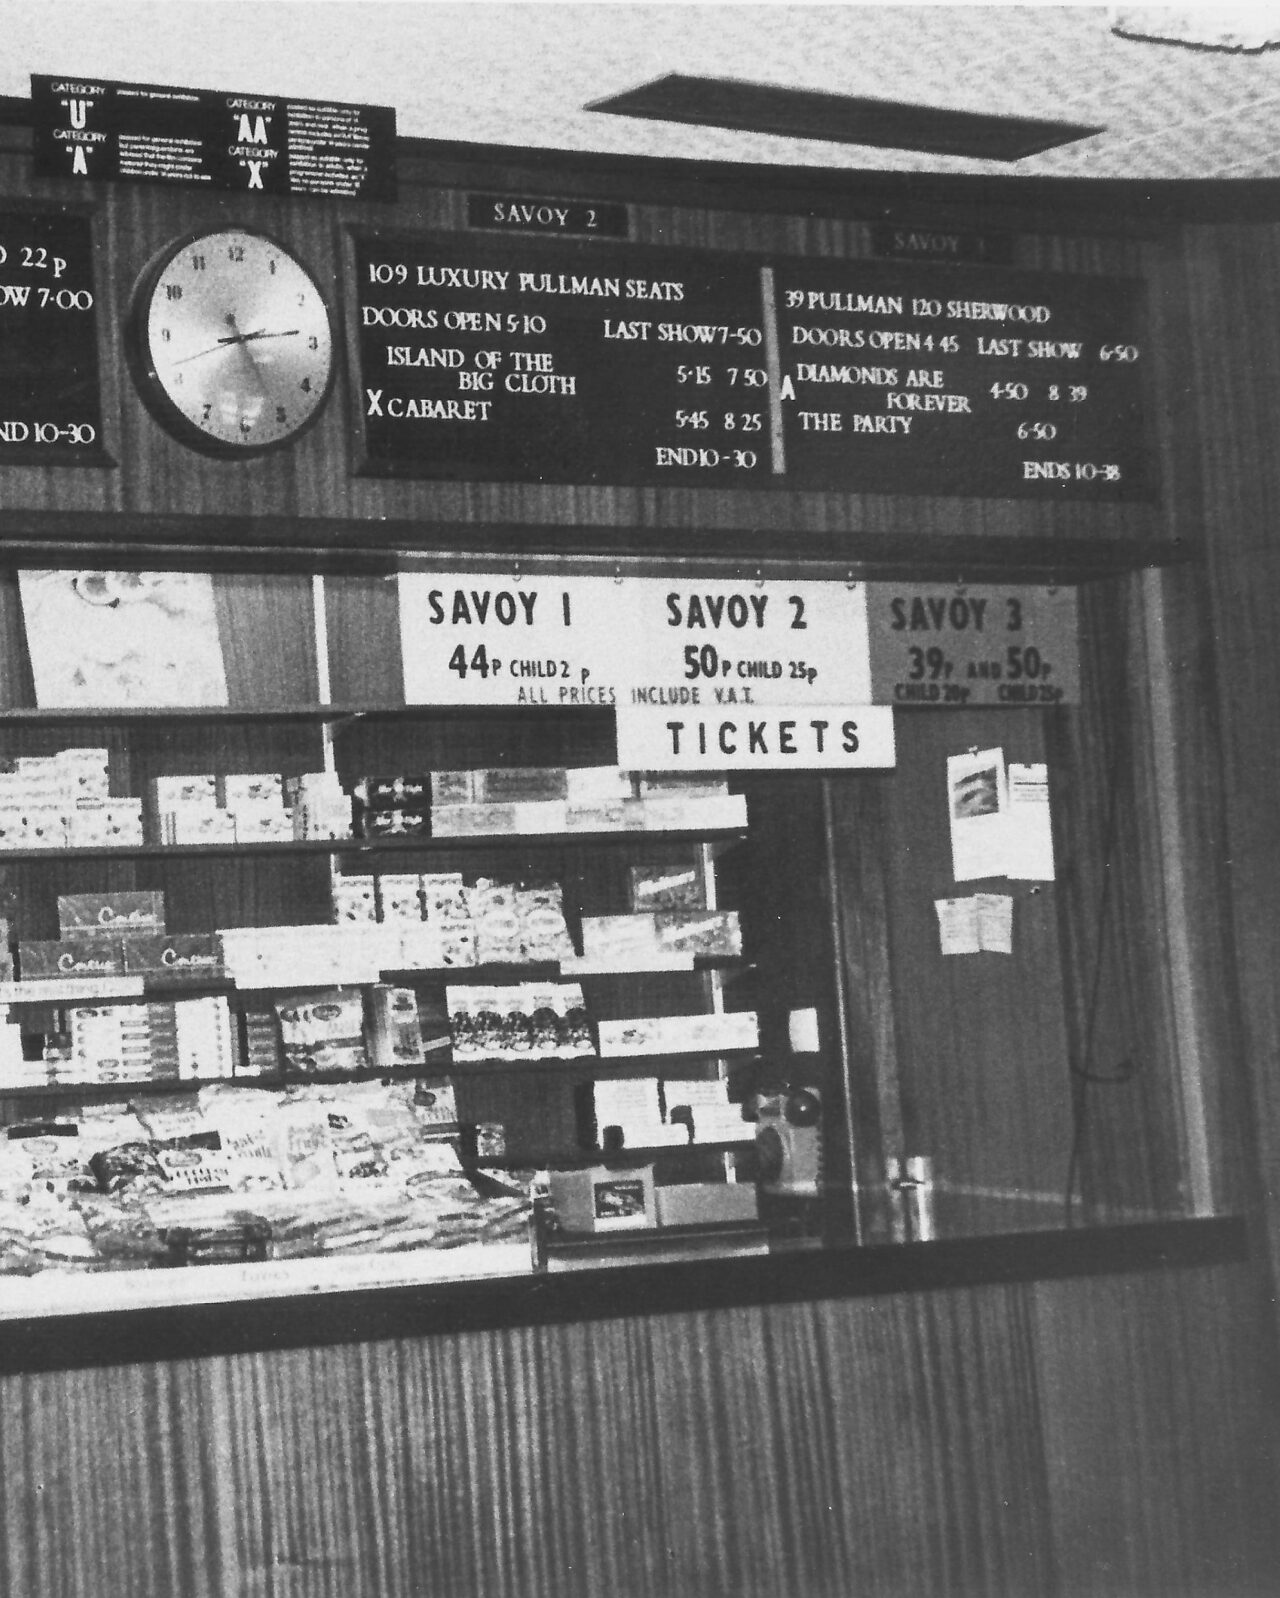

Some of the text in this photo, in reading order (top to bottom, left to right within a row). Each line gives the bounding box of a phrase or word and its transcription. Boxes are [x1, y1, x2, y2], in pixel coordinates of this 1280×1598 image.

[51, 82, 106, 95] CATEGORY
[226, 98, 277, 112] CATEGORY
[53, 129, 108, 143] CATEGORY
[228, 146, 279, 159] CATEGORY
[494, 203, 598, 228] SAVOY 2
[228, 246, 244, 262] 12
[369, 263, 685, 301] 109 LUXURY PULLMAN SEATS
[785, 290, 1051, 323] 39 PULLMAN 120 SHERWOOD
[362, 306, 439, 329] DOORS
[444, 312, 502, 332] OPEN
[604, 320, 652, 340] LAST
[658, 324, 717, 343] SHOW
[792, 326, 865, 348] DOORS
[869, 330, 920, 351] OPEN
[387, 346, 554, 372] ISLAND OF THE
[977, 336, 1023, 357] LAST
[1027, 340, 1083, 359] SHOW
[459, 372, 577, 395] BIG CLOTH
[797, 363, 945, 388] DIAMONDS ARE
[780, 375, 796, 400] A
[366, 389, 384, 417] X
[387, 399, 492, 421] CABARET
[887, 391, 973, 414] FOREVER
[798, 411, 843, 432] THE
[852, 414, 913, 435] PARTY
[656, 447, 698, 467] END
[1023, 461, 1071, 480] ENDS
[428, 590, 538, 626] SAVOY
[666, 592, 808, 629] SAVOY 2
[890, 597, 1022, 631] SAVOY 3
[510, 659, 557, 678] CHILD
[737, 660, 783, 678] CHILD
[967, 661, 1002, 680] AND
[517, 686, 548, 704] ALL
[559, 686, 617, 704] PRICES
[631, 686, 701, 705] INCLUDE
[894, 683, 940, 700] CHILD
[666, 720, 860, 755] TICKETS
